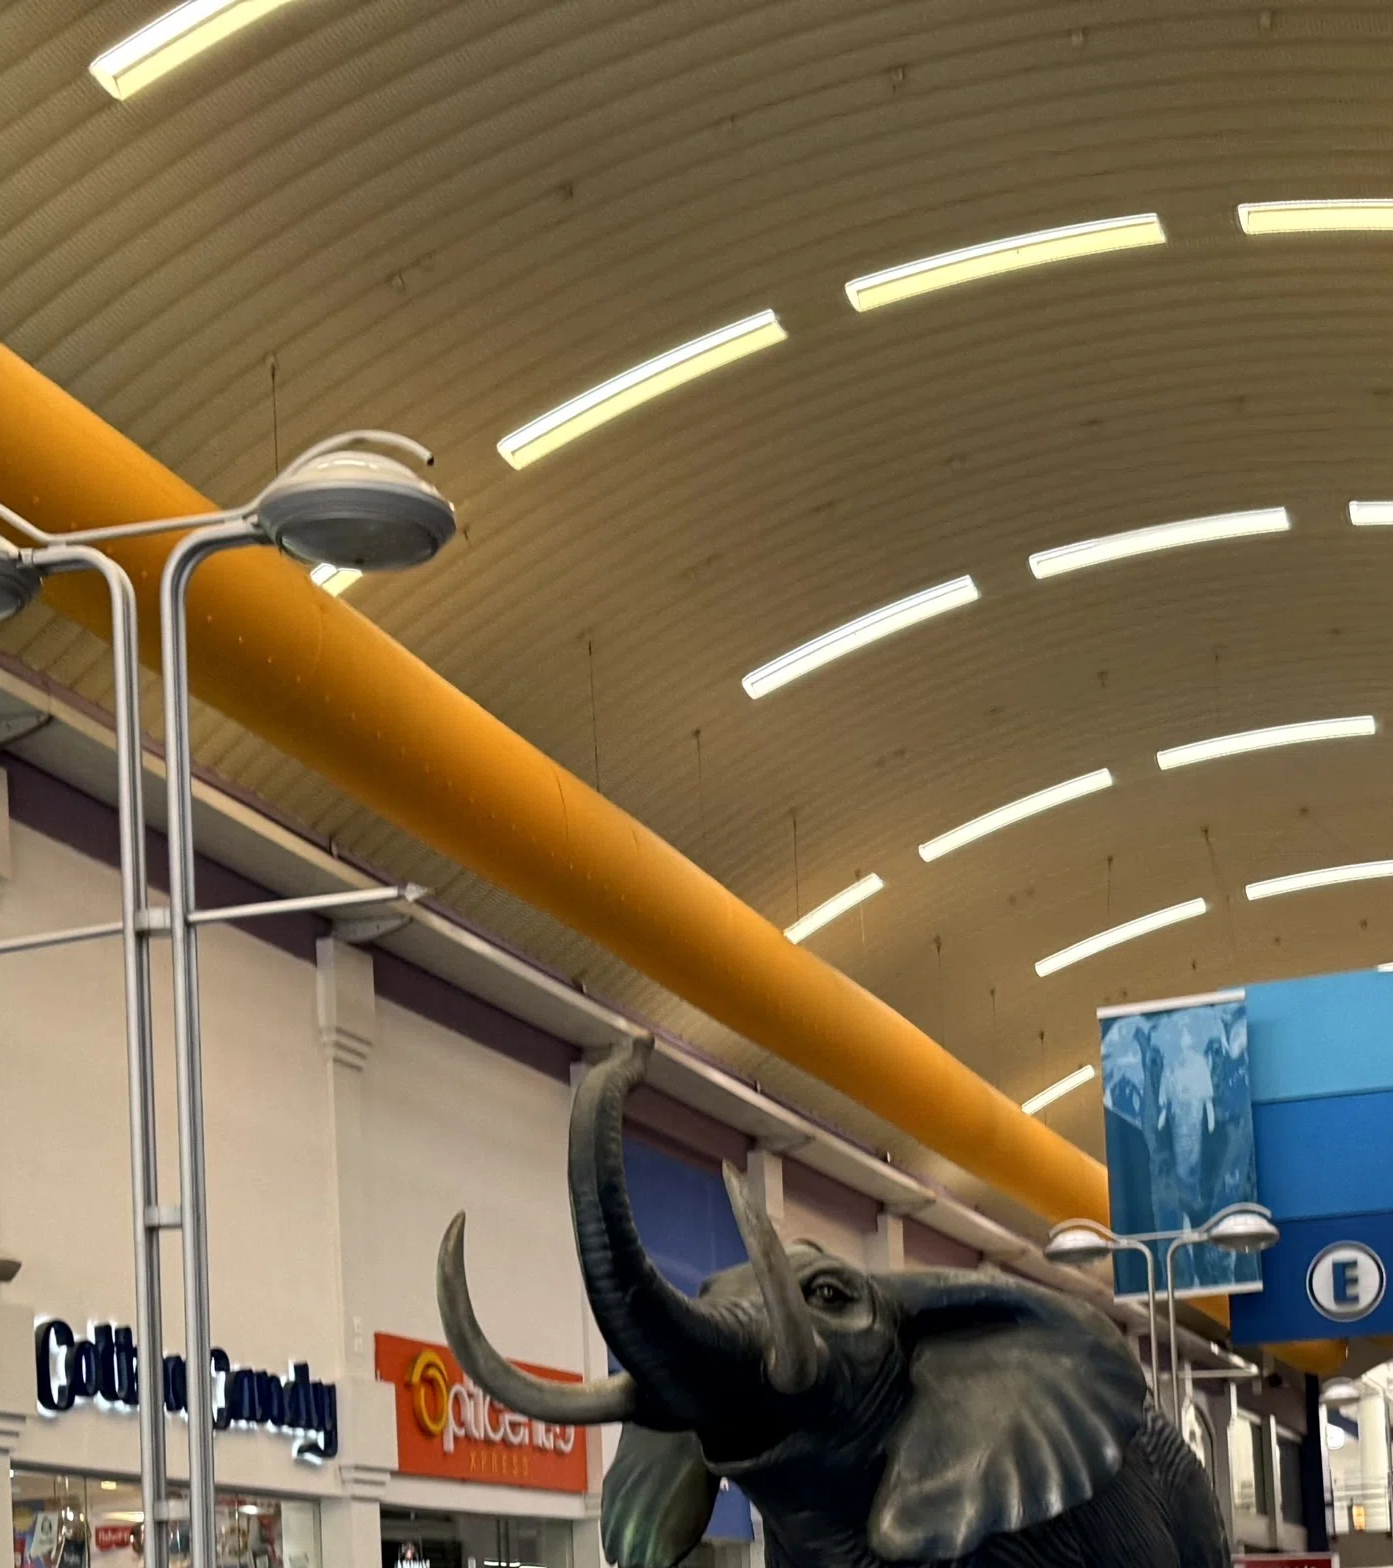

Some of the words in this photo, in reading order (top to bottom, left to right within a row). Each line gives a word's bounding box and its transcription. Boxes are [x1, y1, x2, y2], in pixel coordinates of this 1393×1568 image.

[1331, 1258, 1360, 1306] E
[34, 1320, 187, 1412] Cottn
[469, 1451, 531, 1477] XPRESS
